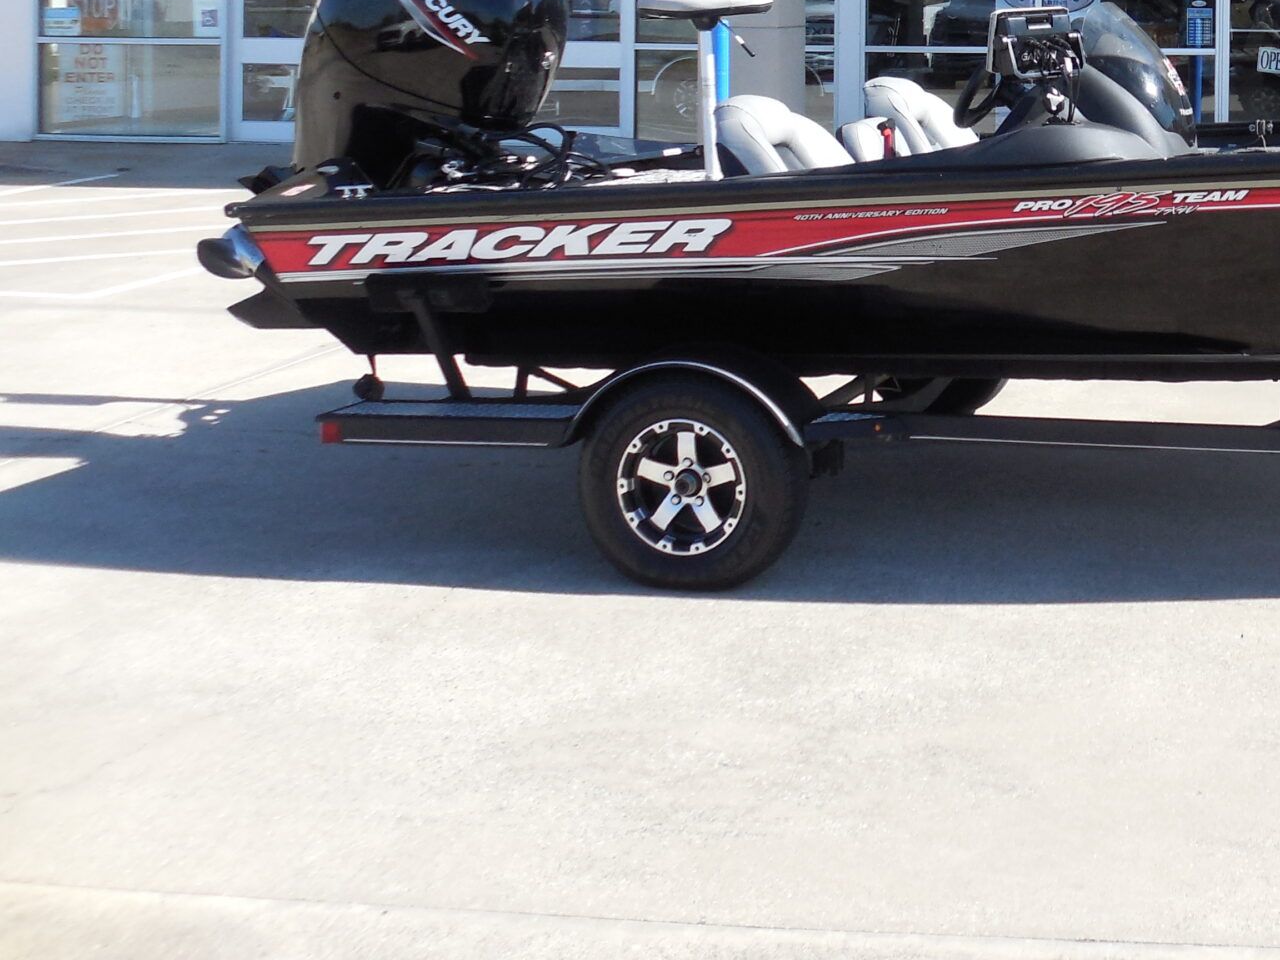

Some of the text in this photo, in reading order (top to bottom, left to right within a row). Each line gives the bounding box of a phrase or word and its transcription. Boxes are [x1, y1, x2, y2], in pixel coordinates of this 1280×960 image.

[793, 207, 949, 221] 40TH ANNIVERSARY EDITION
[1012, 189, 1250, 218] PRO 195 TEAM
[306, 218, 733, 266] TRACKER
